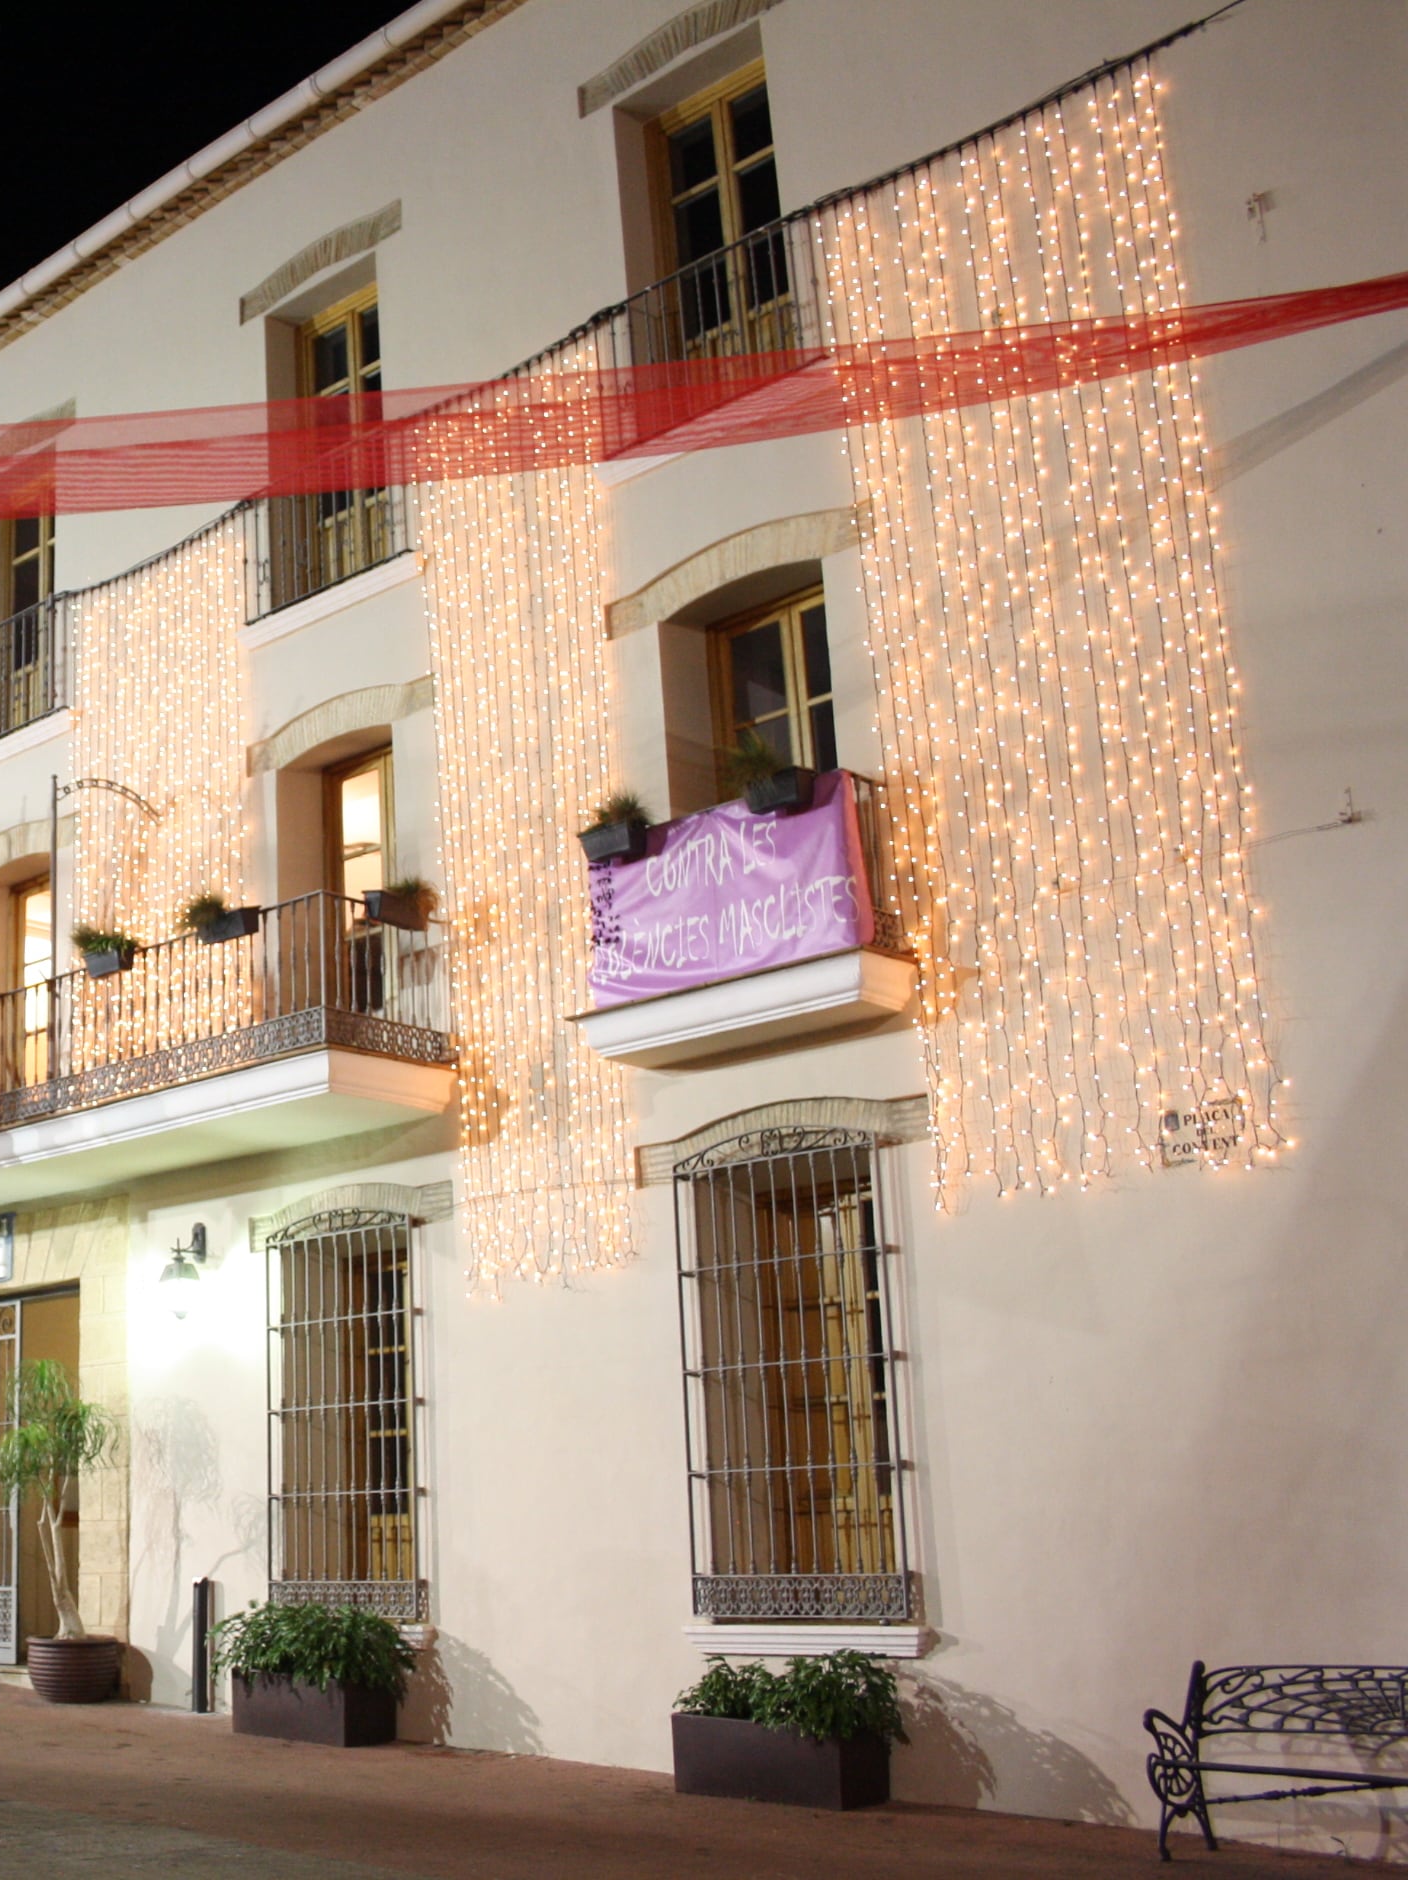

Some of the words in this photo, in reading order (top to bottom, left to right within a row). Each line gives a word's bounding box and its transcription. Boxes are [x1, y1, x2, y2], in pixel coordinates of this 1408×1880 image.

[644, 830, 734, 897] CONTRA
[740, 820, 778, 875] LES
[718, 874, 859, 957] MASCLISTES
